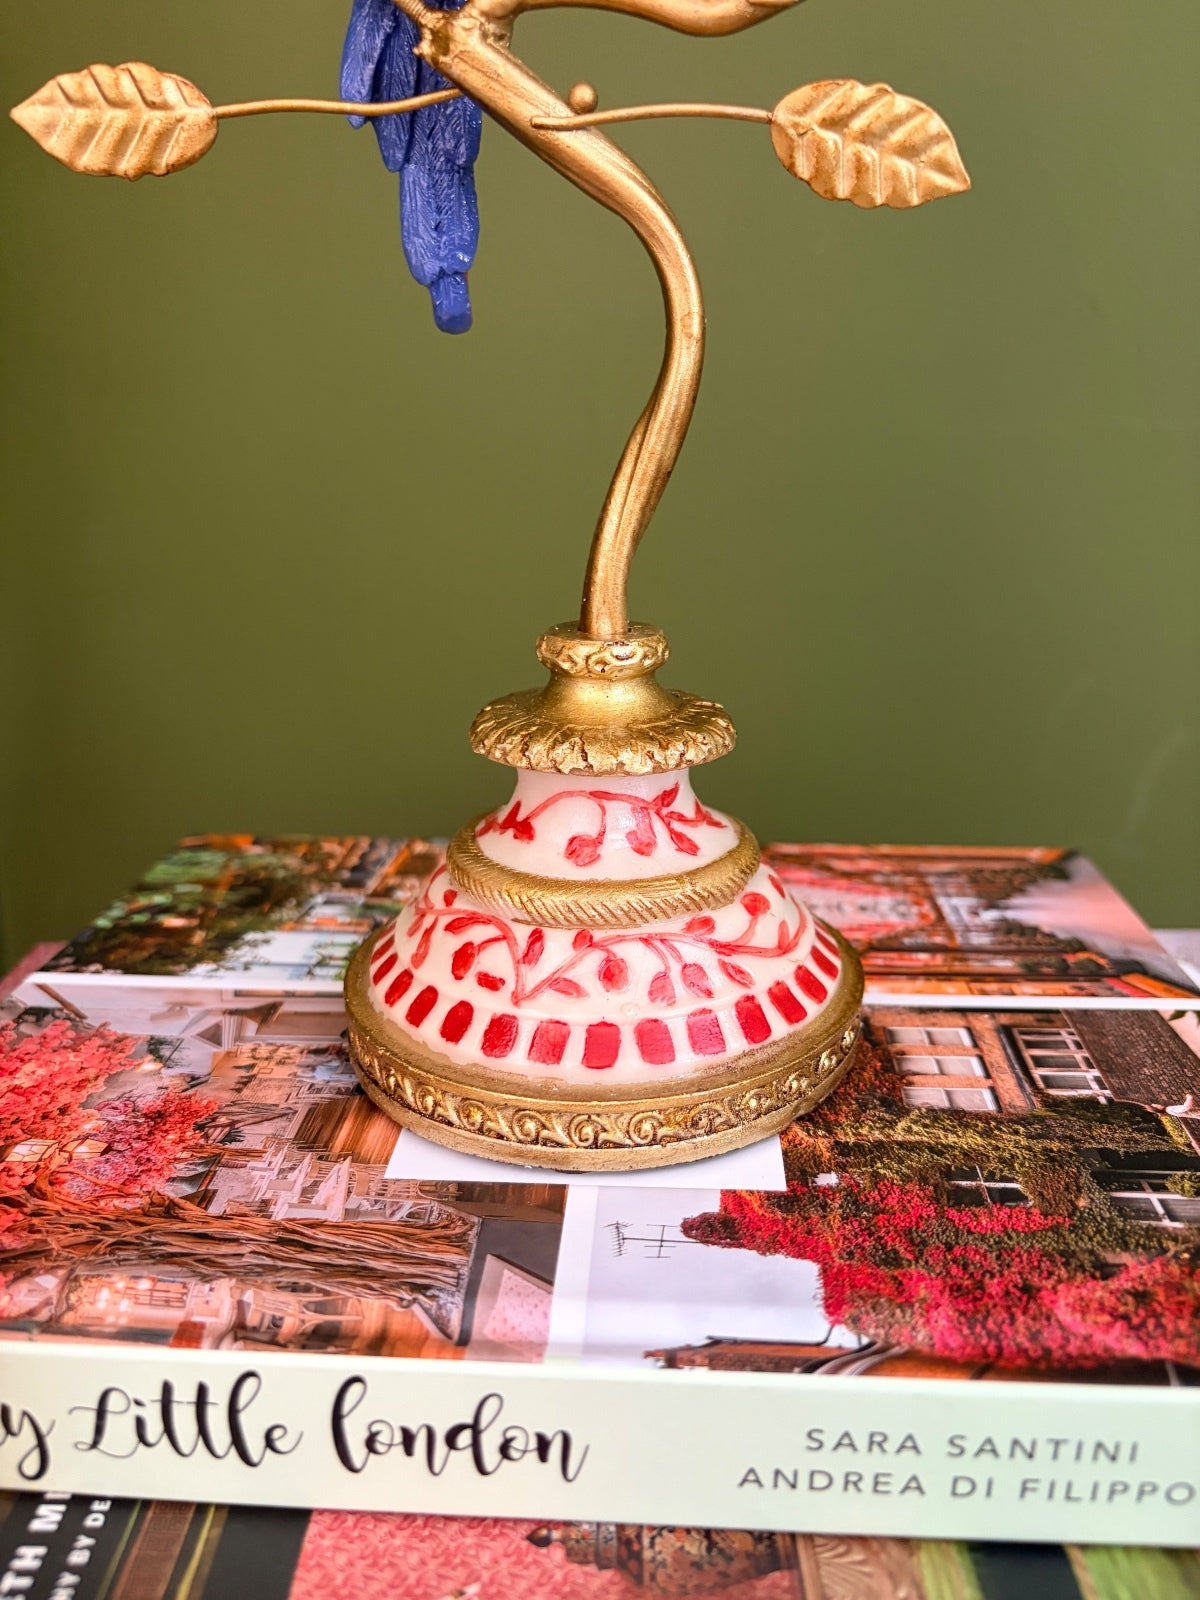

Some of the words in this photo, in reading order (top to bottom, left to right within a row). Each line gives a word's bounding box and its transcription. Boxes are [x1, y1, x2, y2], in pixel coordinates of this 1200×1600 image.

[0, 1402, 56, 1481] y
[68, 1370, 303, 1468] Little
[330, 1374, 589, 1483] london
[805, 1428, 922, 1457] SARA
[946, 1434, 1139, 1464] SANTINI
[737, 1466, 926, 1497] ANDREA
[950, 1475, 994, 1499] DI
[1018, 1477, 1197, 1506] FILIPPO
[66, 1534, 96, 1567] BY
